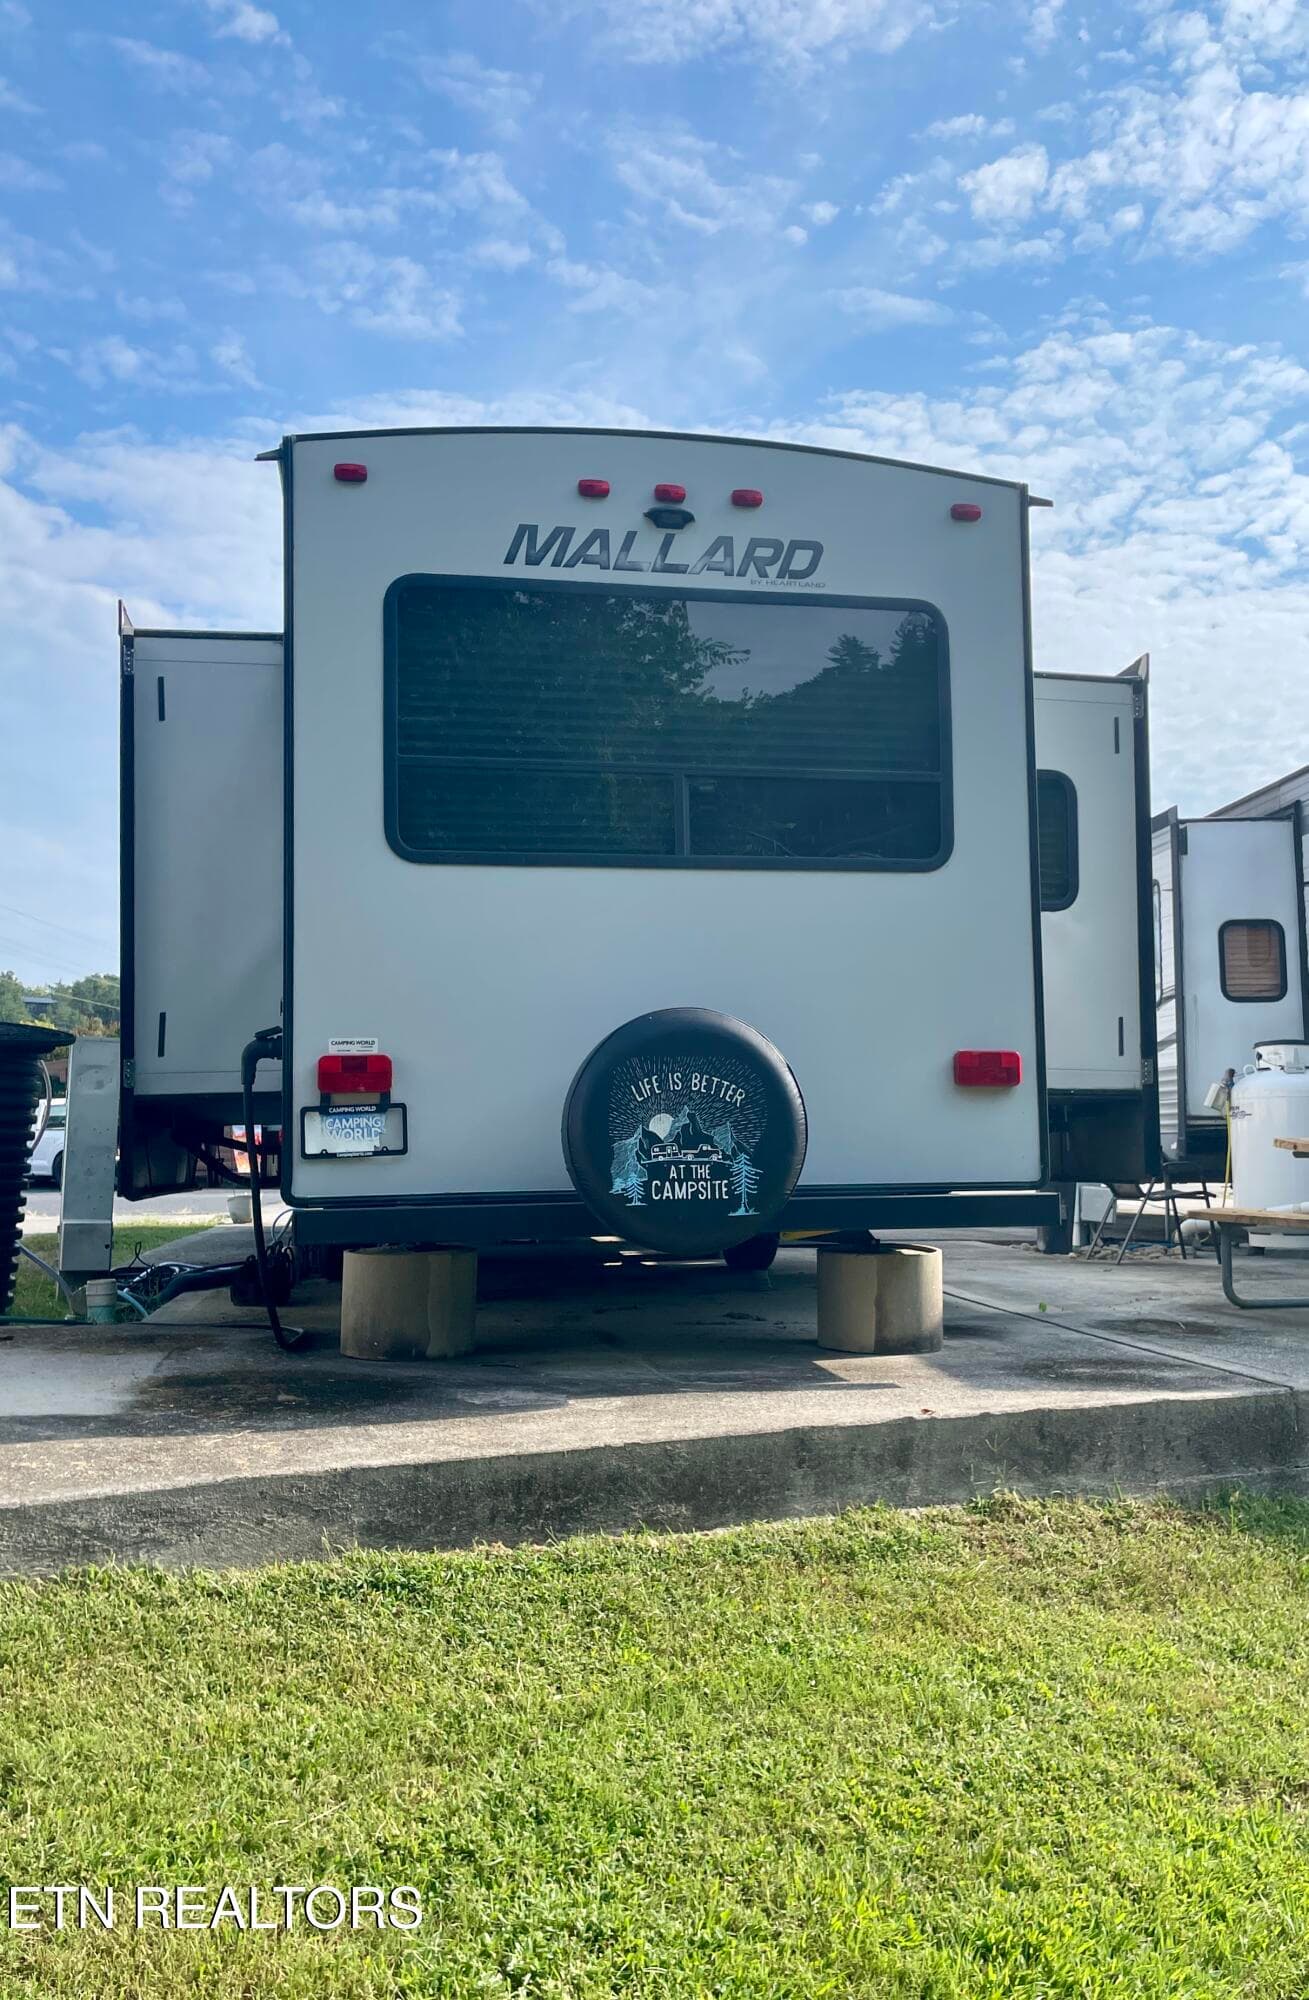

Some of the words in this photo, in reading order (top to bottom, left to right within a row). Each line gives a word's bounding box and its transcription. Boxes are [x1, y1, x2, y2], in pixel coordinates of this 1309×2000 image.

[503, 523, 824, 579] MALLARD
[765, 579, 826, 588] HEARTLAND
[631, 1075, 662, 1102] LIFE
[668, 1072, 682, 1091] IS
[691, 1072, 746, 1107] BETTER
[325, 1117, 381, 1130] CAMPING
[327, 1128, 380, 1141] WORLD
[669, 1164, 686, 1179] AT
[689, 1164, 711, 1179] THE
[651, 1180, 729, 1200] CAMPSITE
